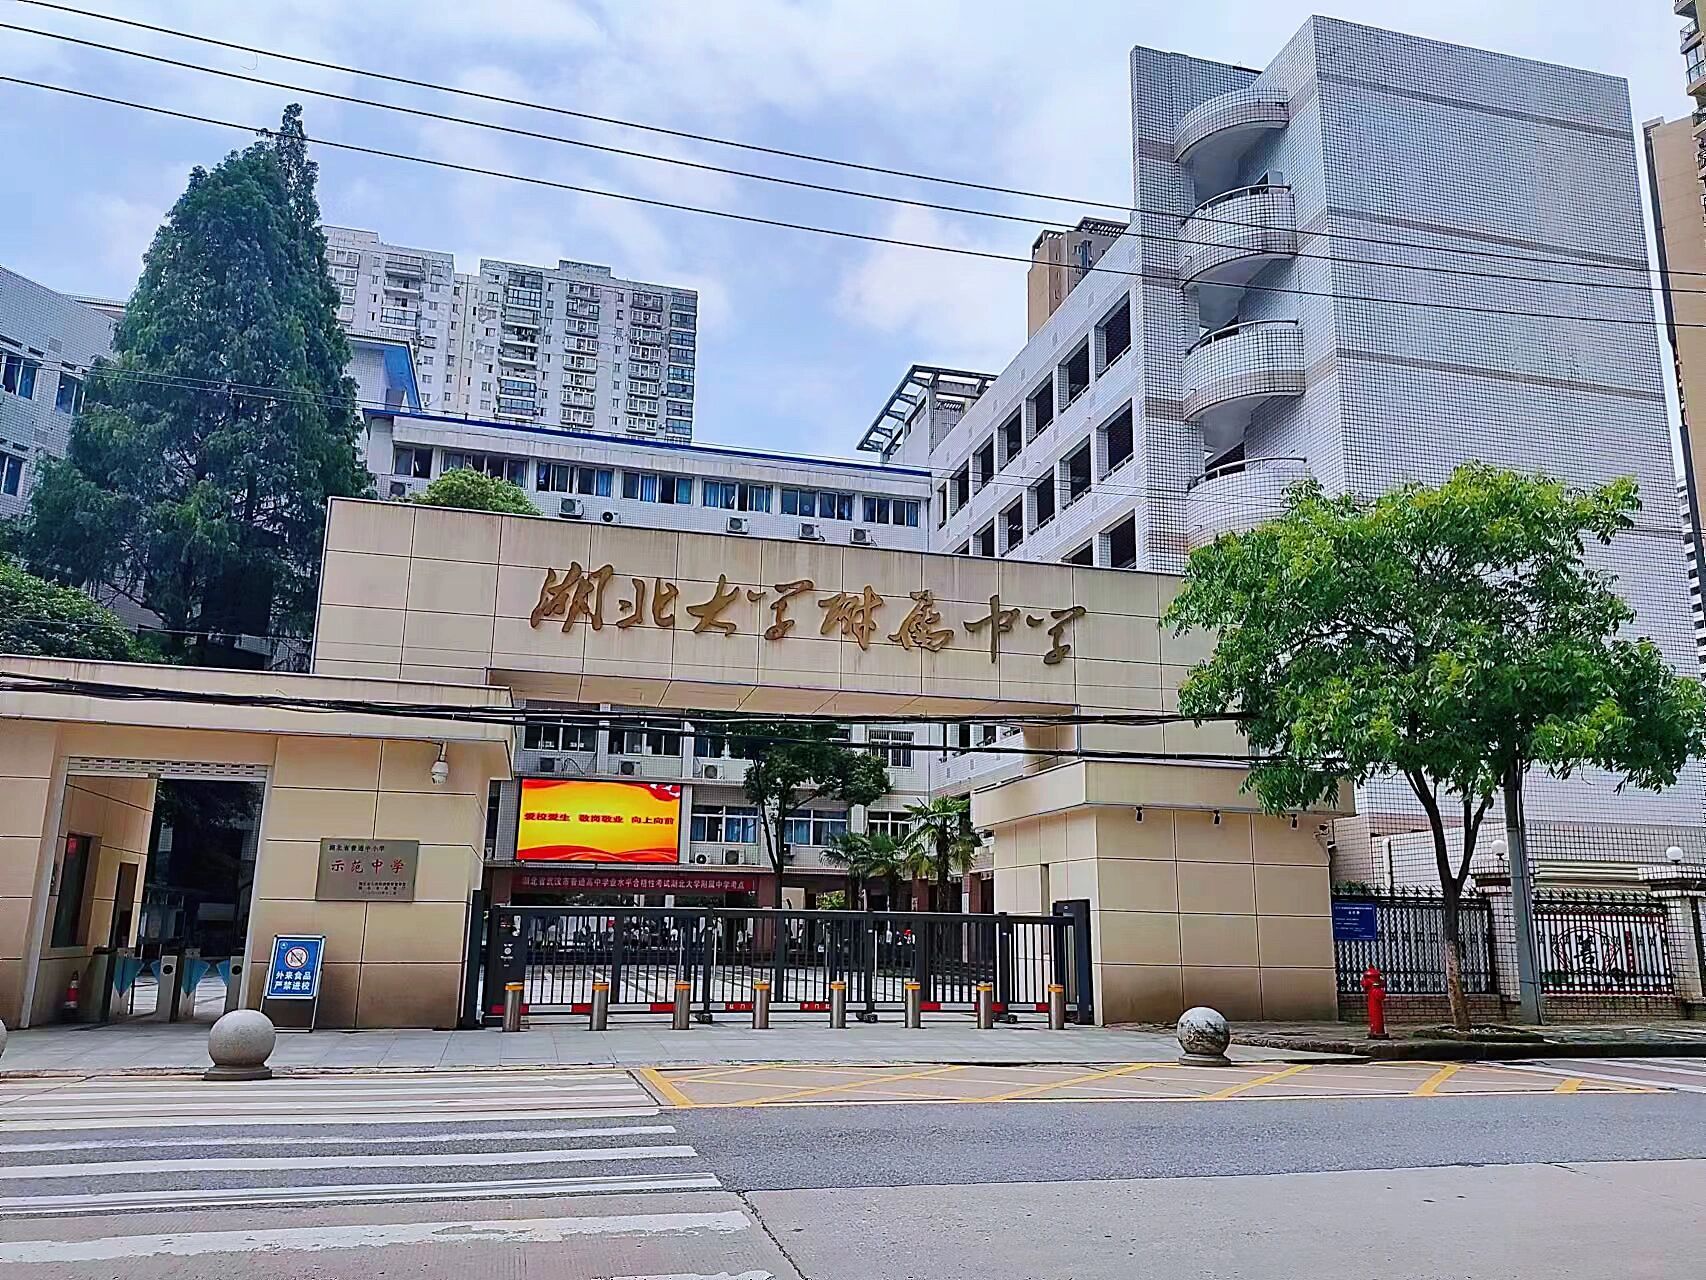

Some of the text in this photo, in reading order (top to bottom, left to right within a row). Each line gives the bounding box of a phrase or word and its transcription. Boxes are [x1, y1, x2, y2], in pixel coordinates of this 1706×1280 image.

[531, 561, 1087, 666] 湖北大学附属中学
[524, 812, 674, 824] 爱校爱生 敬岗敬业 向上向前
[331, 859, 404, 874] 示范中学
[275, 971, 311, 980] 外来食品
[273, 980, 310, 991] 严禁进校
